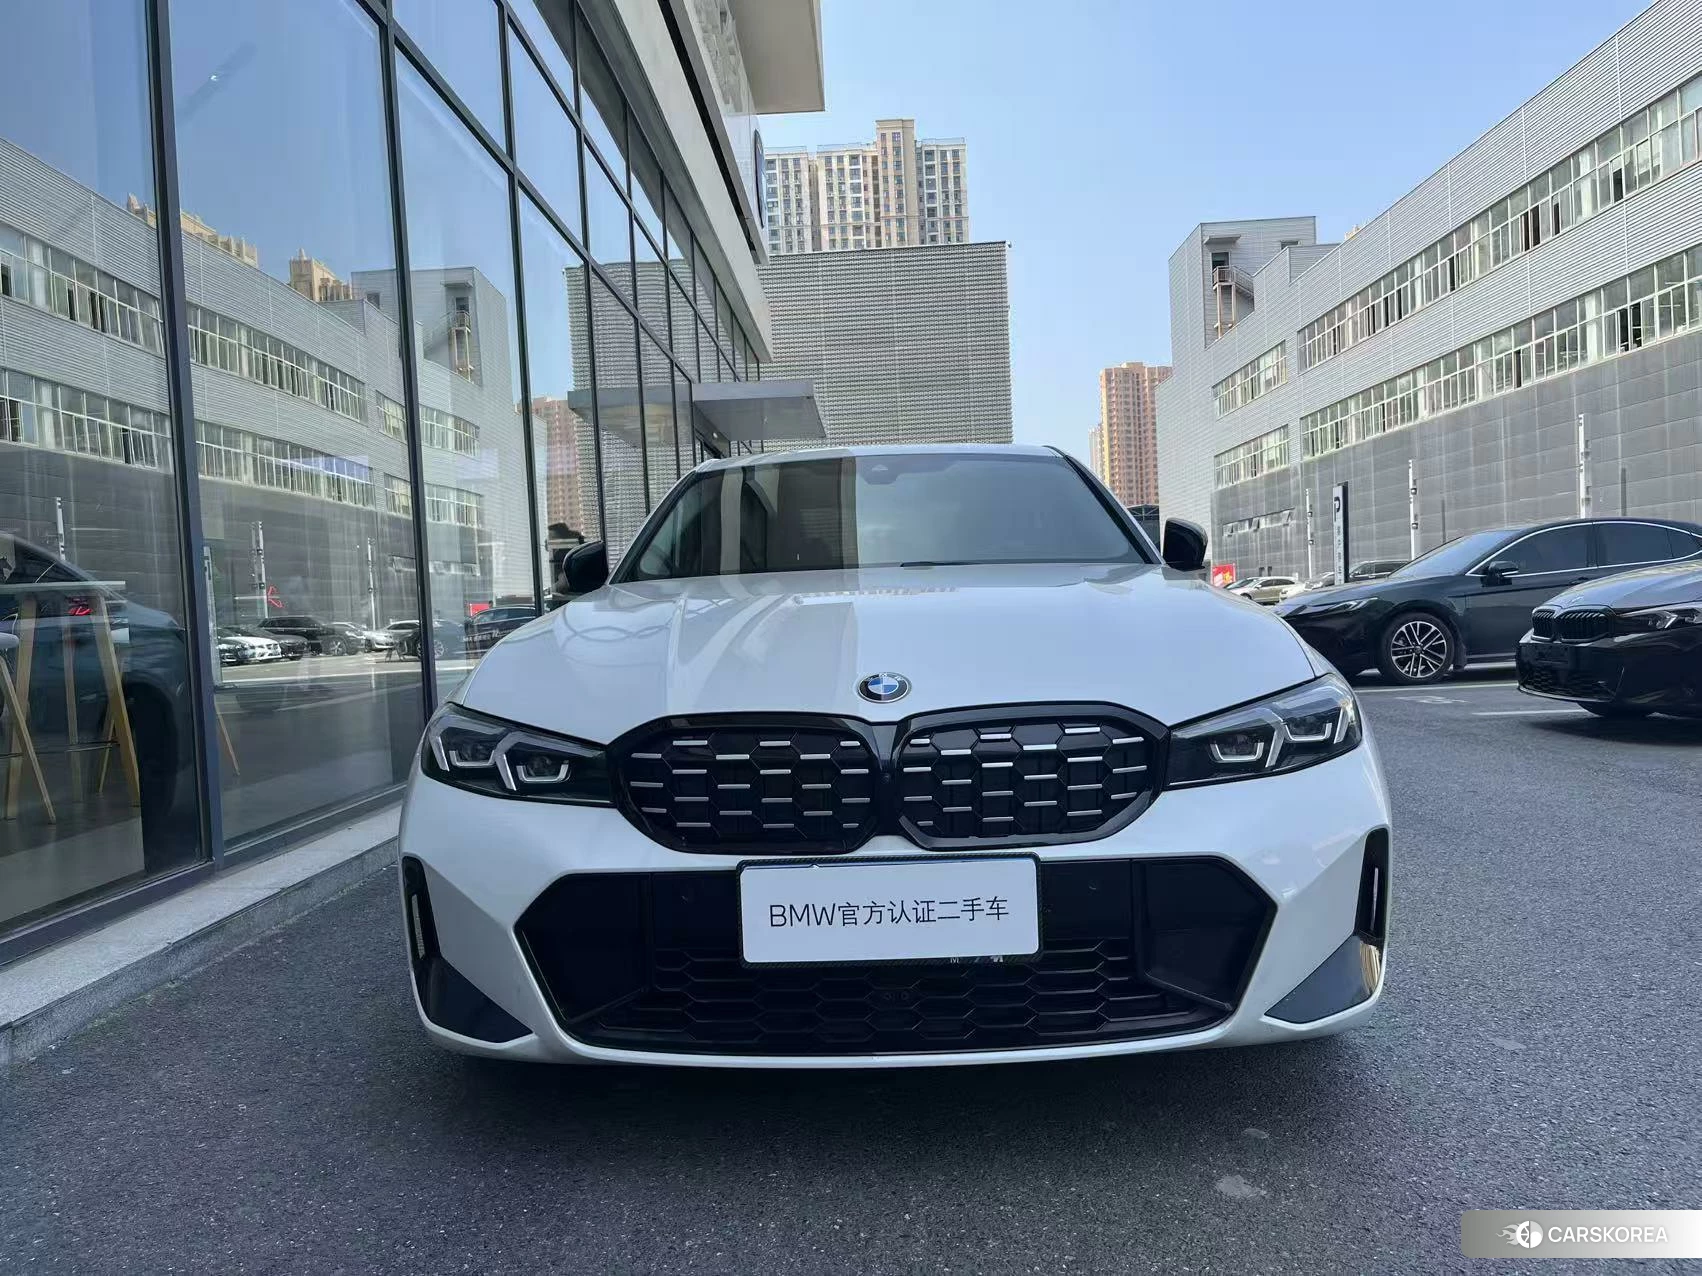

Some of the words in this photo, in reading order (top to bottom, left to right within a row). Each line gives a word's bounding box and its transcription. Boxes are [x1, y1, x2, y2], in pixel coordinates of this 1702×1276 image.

[769, 896, 1010, 928] BMW官方认证二手车
